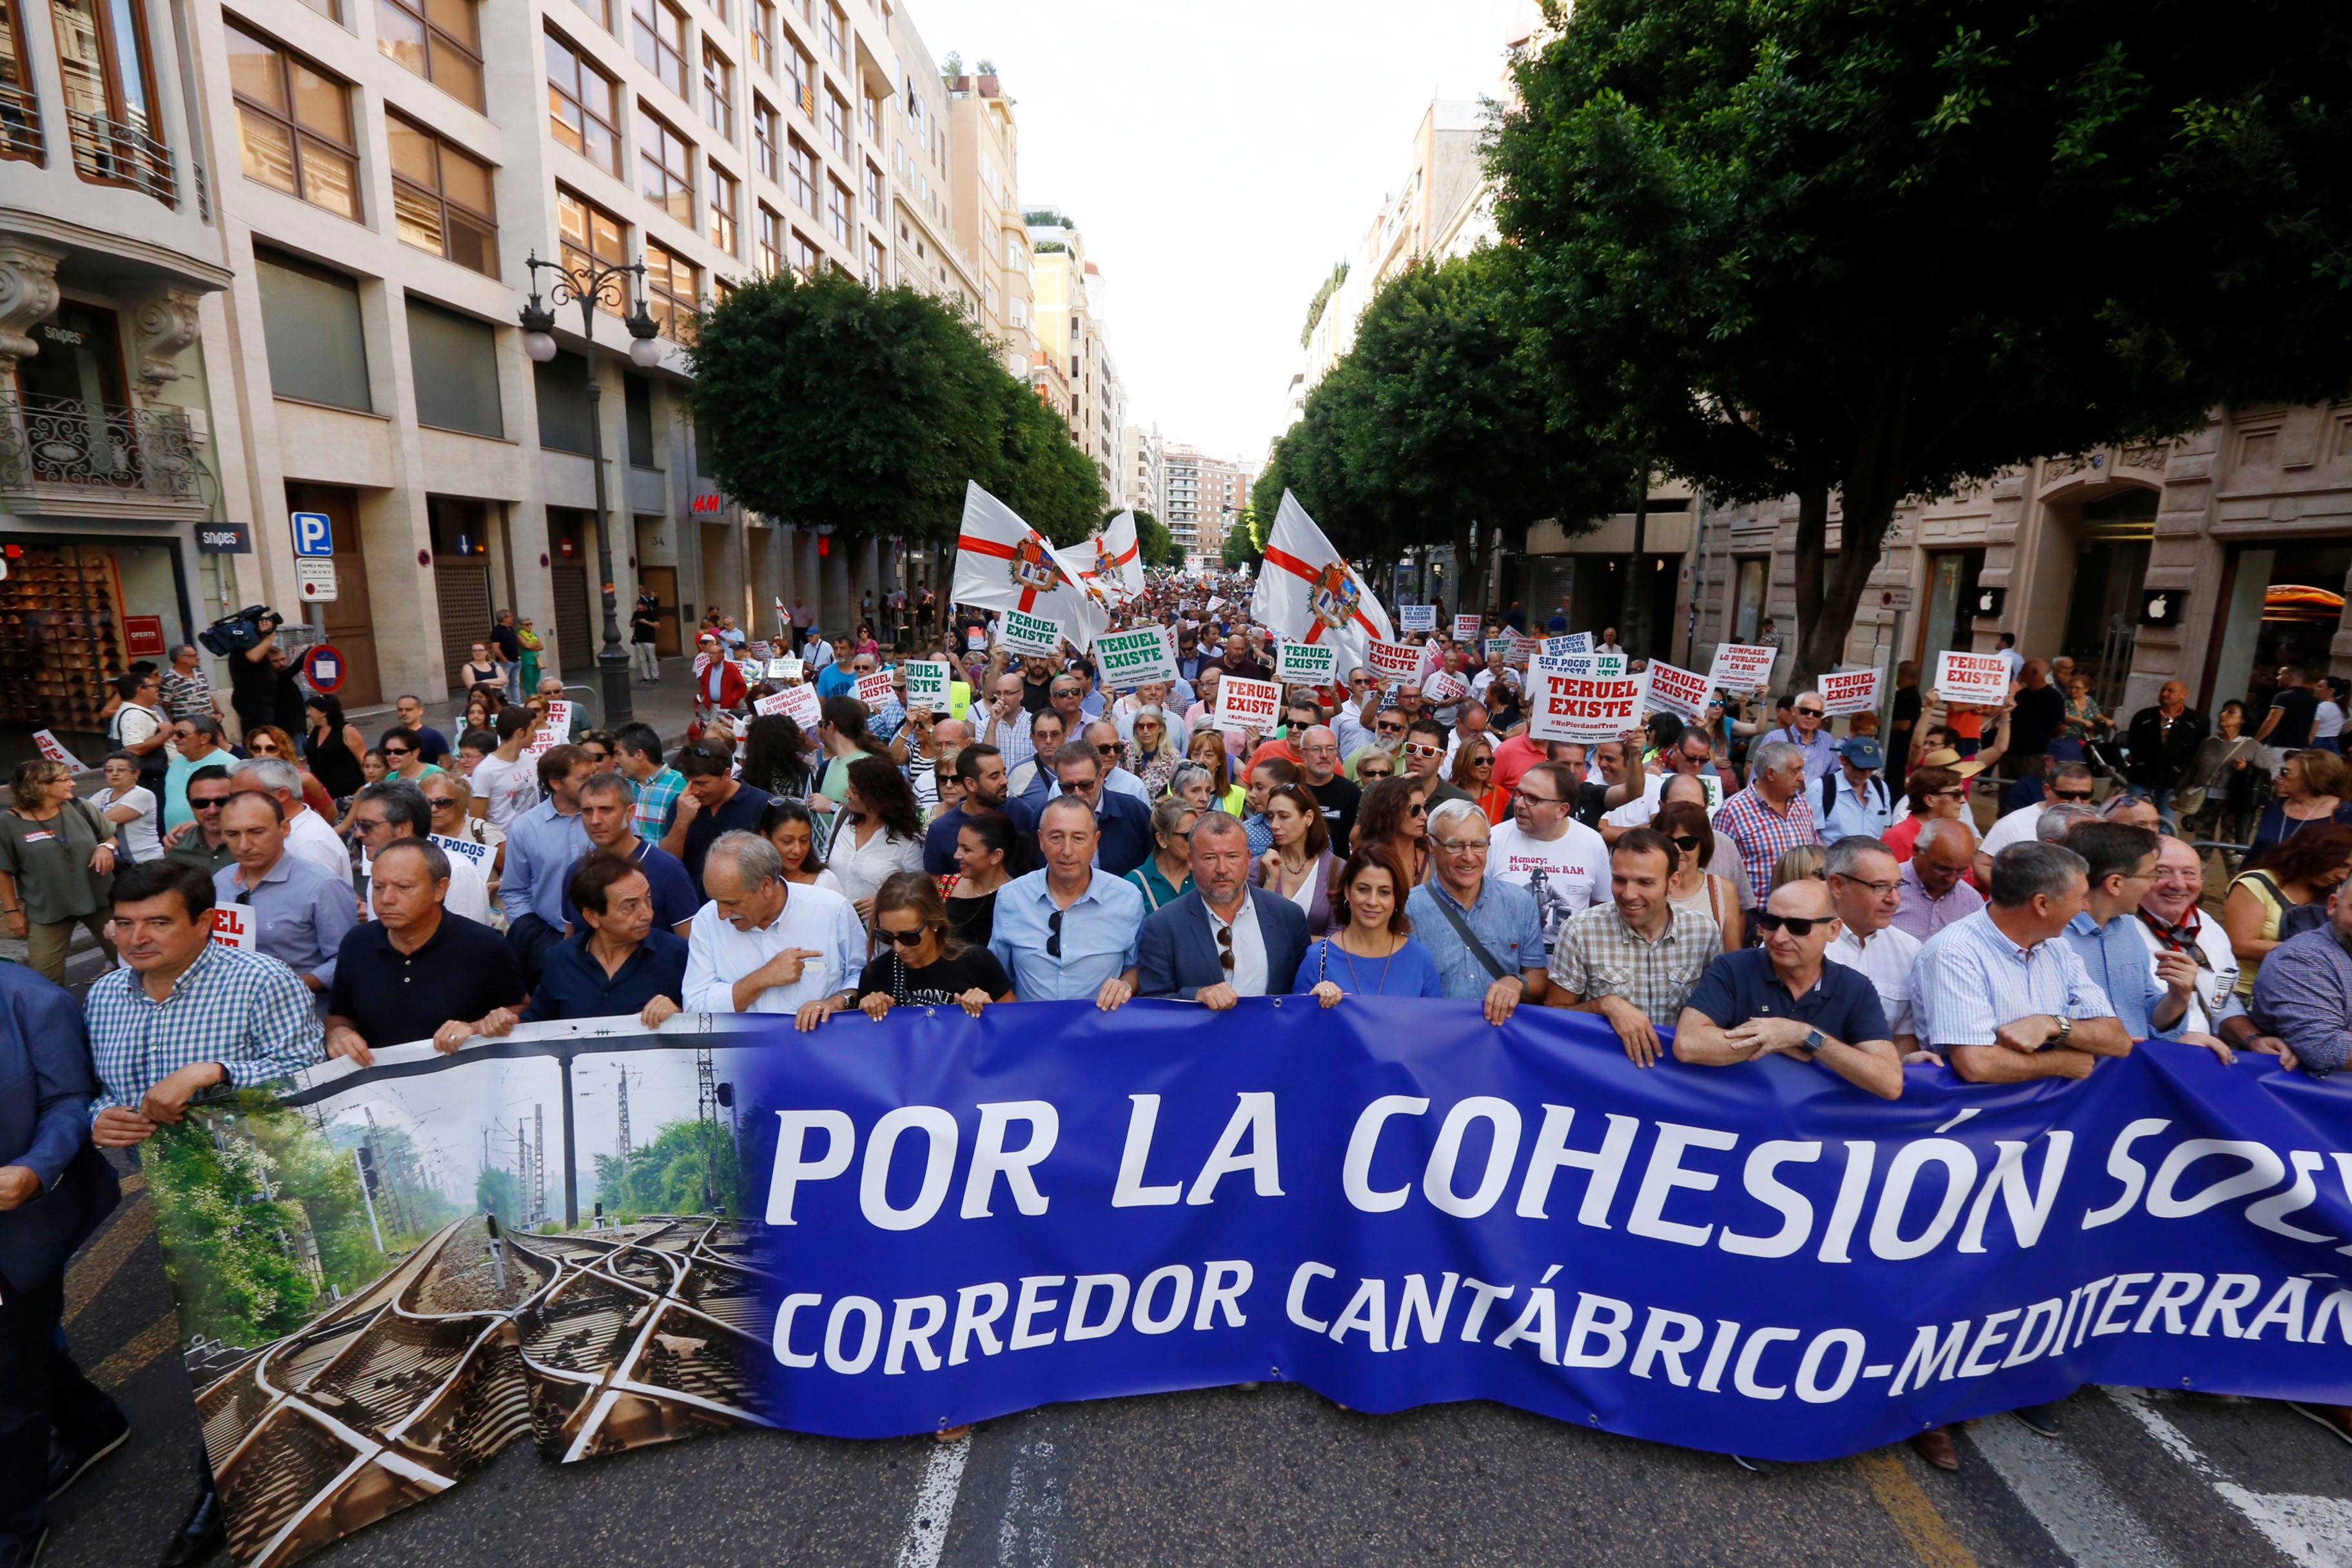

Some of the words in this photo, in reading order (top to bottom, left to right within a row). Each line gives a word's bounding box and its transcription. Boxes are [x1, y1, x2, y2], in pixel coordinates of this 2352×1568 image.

[692, 495, 719, 513] H&M
[203, 532, 236, 546] snipes
[300, 516, 324, 552] P
[652, 536, 664, 546] 34
[1007, 610, 1058, 632] TERUEL
[1006, 623, 1055, 644] EXISTE
[1097, 632, 1161, 653] TERUEL
[1563, 634, 1585, 643] POCOS
[1284, 645, 1333, 658] TERUEL
[1369, 640, 1419, 660] TERUEL
[1561, 640, 1585, 649] RESTA
[1103, 647, 1163, 669] EXISTE
[1284, 657, 1329, 670] EXISTE
[1369, 652, 1416, 671] EXISTE
[1538, 656, 1558, 665] SER
[1562, 659, 1591, 668] POCOS
[1730, 655, 1770, 664] PUBLICADO
[1947, 656, 2004, 672] TERUEL
[858, 674, 890, 690] TERUEL
[1440, 674, 1467, 694] TERUEL
[1654, 665, 1707, 693] TERUEL
[1825, 673, 1876, 689] TERUEL
[1947, 670, 2001, 685] EXISTE
[860, 684, 891, 700] EXISTE
[1226, 681, 1277, 700] TERUEL
[1547, 676, 1638, 698] TERUEL
[1652, 678, 1702, 705] EXISTE
[1827, 685, 1872, 701] EXISTE
[762, 707, 772, 715] LO
[773, 693, 811, 711] PUBLICADO
[788, 704, 802, 714] BOE
[1226, 696, 1274, 715] EXISTE
[1547, 697, 1633, 718] EXISTE
[443, 839, 485, 857] POCOS
[1509, 856, 1547, 865] Memory:
[1562, 865, 1585, 875] RAM
[765, 1100, 1059, 1230] POR
[1112, 1092, 1285, 1208] LA
[1342, 1095, 2074, 1264] COHESIÓN
[773, 1260, 1253, 1375] CORREDOR
